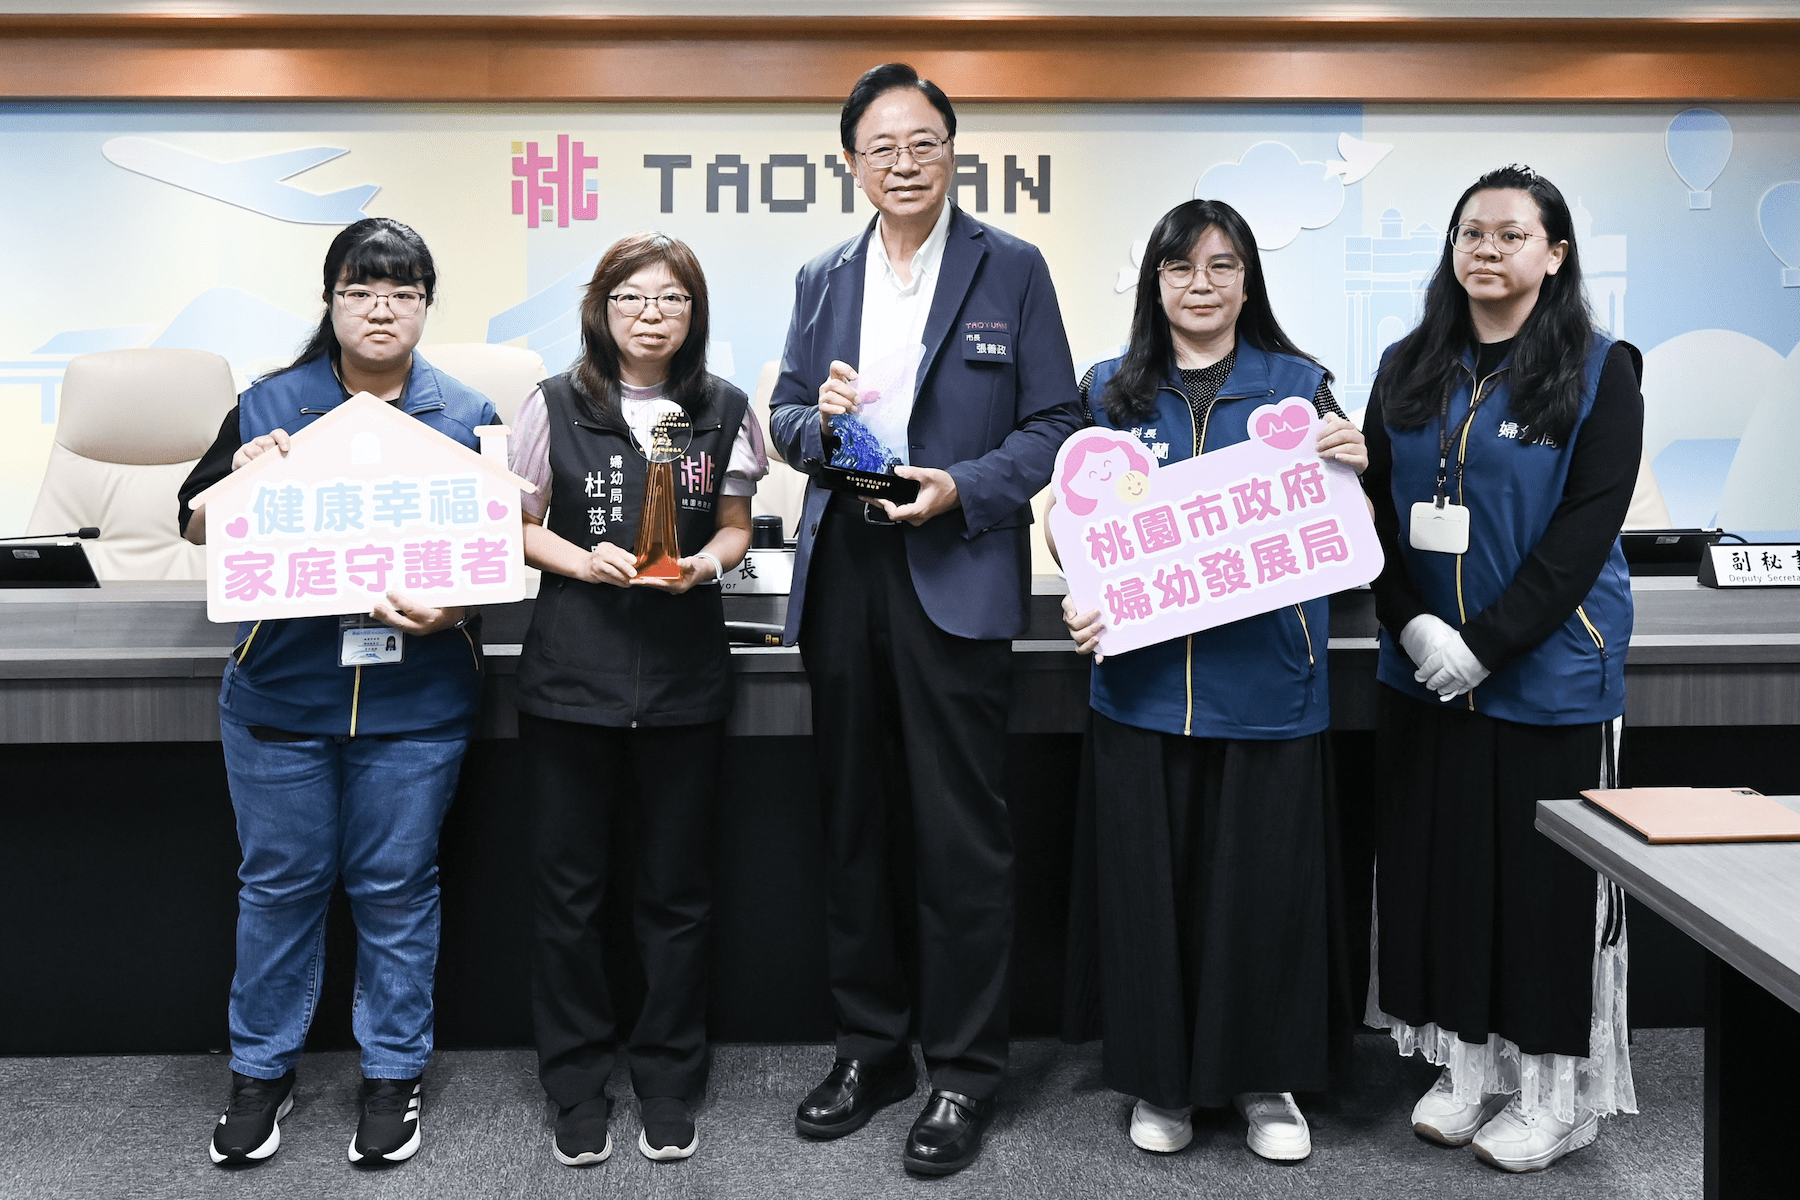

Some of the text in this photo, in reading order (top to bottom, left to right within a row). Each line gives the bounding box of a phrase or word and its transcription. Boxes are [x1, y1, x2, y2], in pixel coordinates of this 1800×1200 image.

[643, 153, 1051, 214] TAOYAN
[965, 321, 1007, 330] TAOYUAN
[965, 333, 981, 342] 市長
[976, 342, 1007, 356] 張善政
[1141, 441, 1170, 460] 蘭
[252, 477, 480, 536] 健康幸福
[584, 470, 607, 553] 杜慈
[608, 454, 624, 523] 婦幼局長
[1085, 461, 1328, 569] 桃園市政府
[223, 537, 510, 603] 家庭守護者
[1103, 518, 1350, 627] 婦幼發展局
[1728, 574, 1763, 584] Deputy
